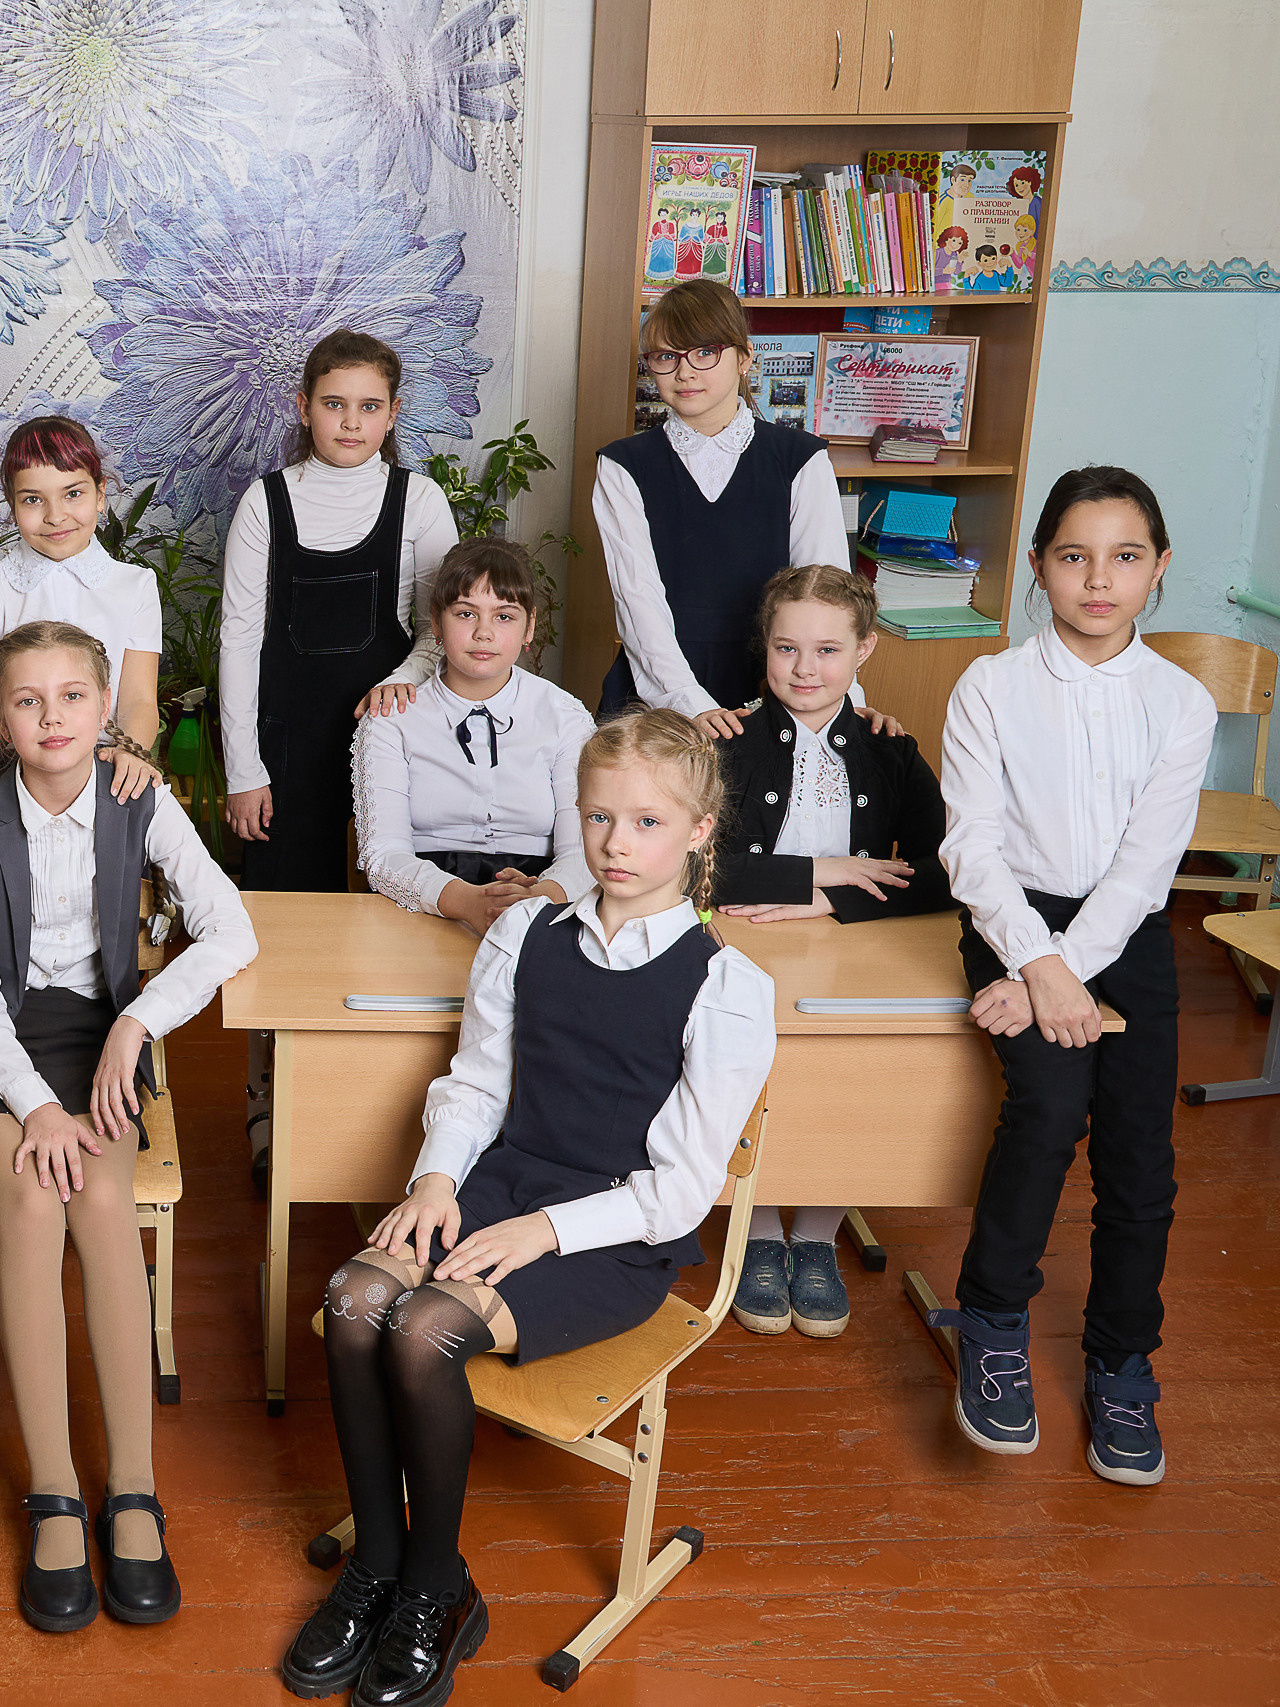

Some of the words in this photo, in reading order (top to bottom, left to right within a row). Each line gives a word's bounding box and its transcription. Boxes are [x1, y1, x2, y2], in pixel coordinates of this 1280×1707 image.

[975, 200, 1012, 208] РАЗГОВОР
[970, 208, 1020, 217] ПРАВИЛЬНОМ
[974, 217, 1010, 225] ПИТАНИИ
[874, 314, 903, 328] ДЕТИ
[837, 354, 957, 379] Сертификат
